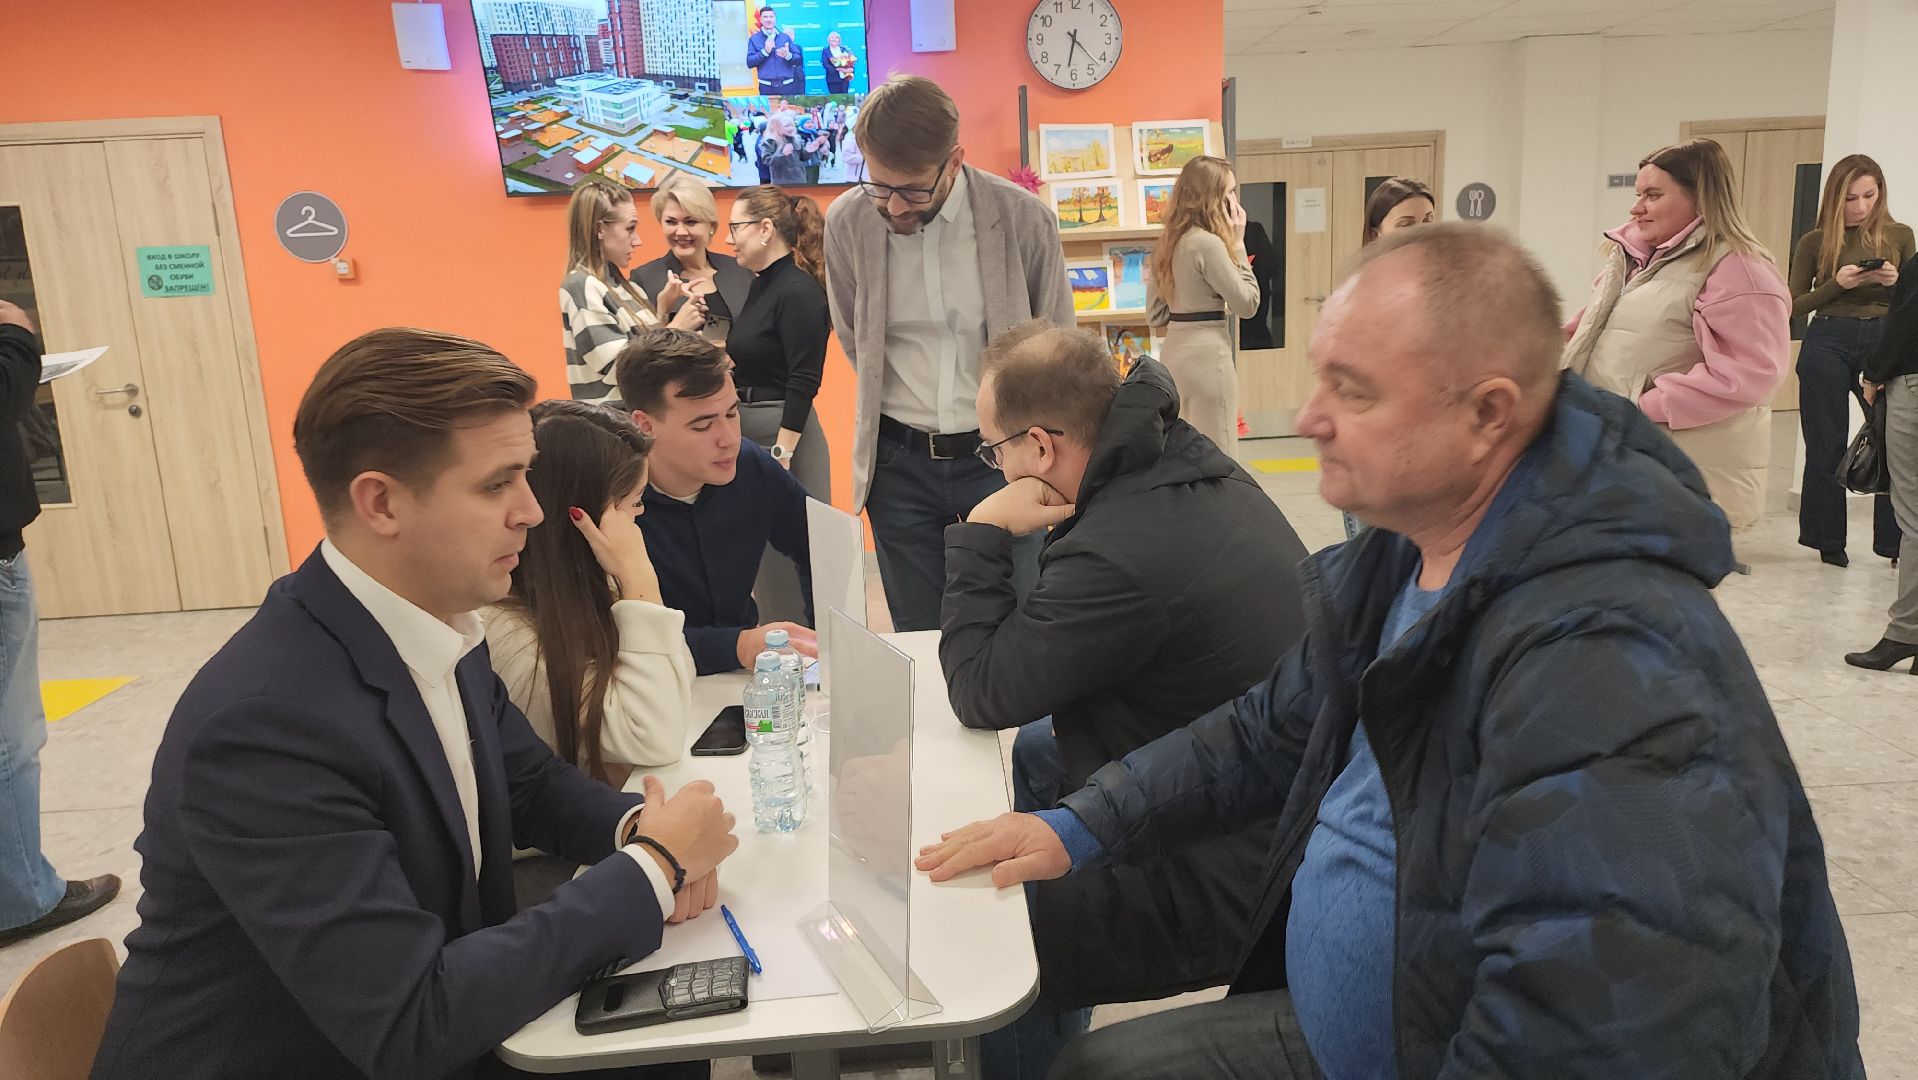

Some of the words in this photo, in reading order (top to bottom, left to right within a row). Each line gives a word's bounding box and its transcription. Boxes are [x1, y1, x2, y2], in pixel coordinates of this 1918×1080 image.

[1053, 2, 1063, 13] 11
[1070, 0, 1081, 9] 12
[1088, 3, 1094, 14] 1
[1040, 15, 1052, 27] 10
[1100, 15, 1108, 26] 2
[1036, 33, 1044, 45] 9
[1104, 33, 1112, 45] 3
[1041, 52, 1048, 64] 8
[1099, 51, 1106, 62] 4
[1053, 64, 1061, 76] 7
[1070, 69, 1078, 80] 6
[1086, 64, 1094, 76] 5
[169, 262, 204, 270] СМЕННОЙ
